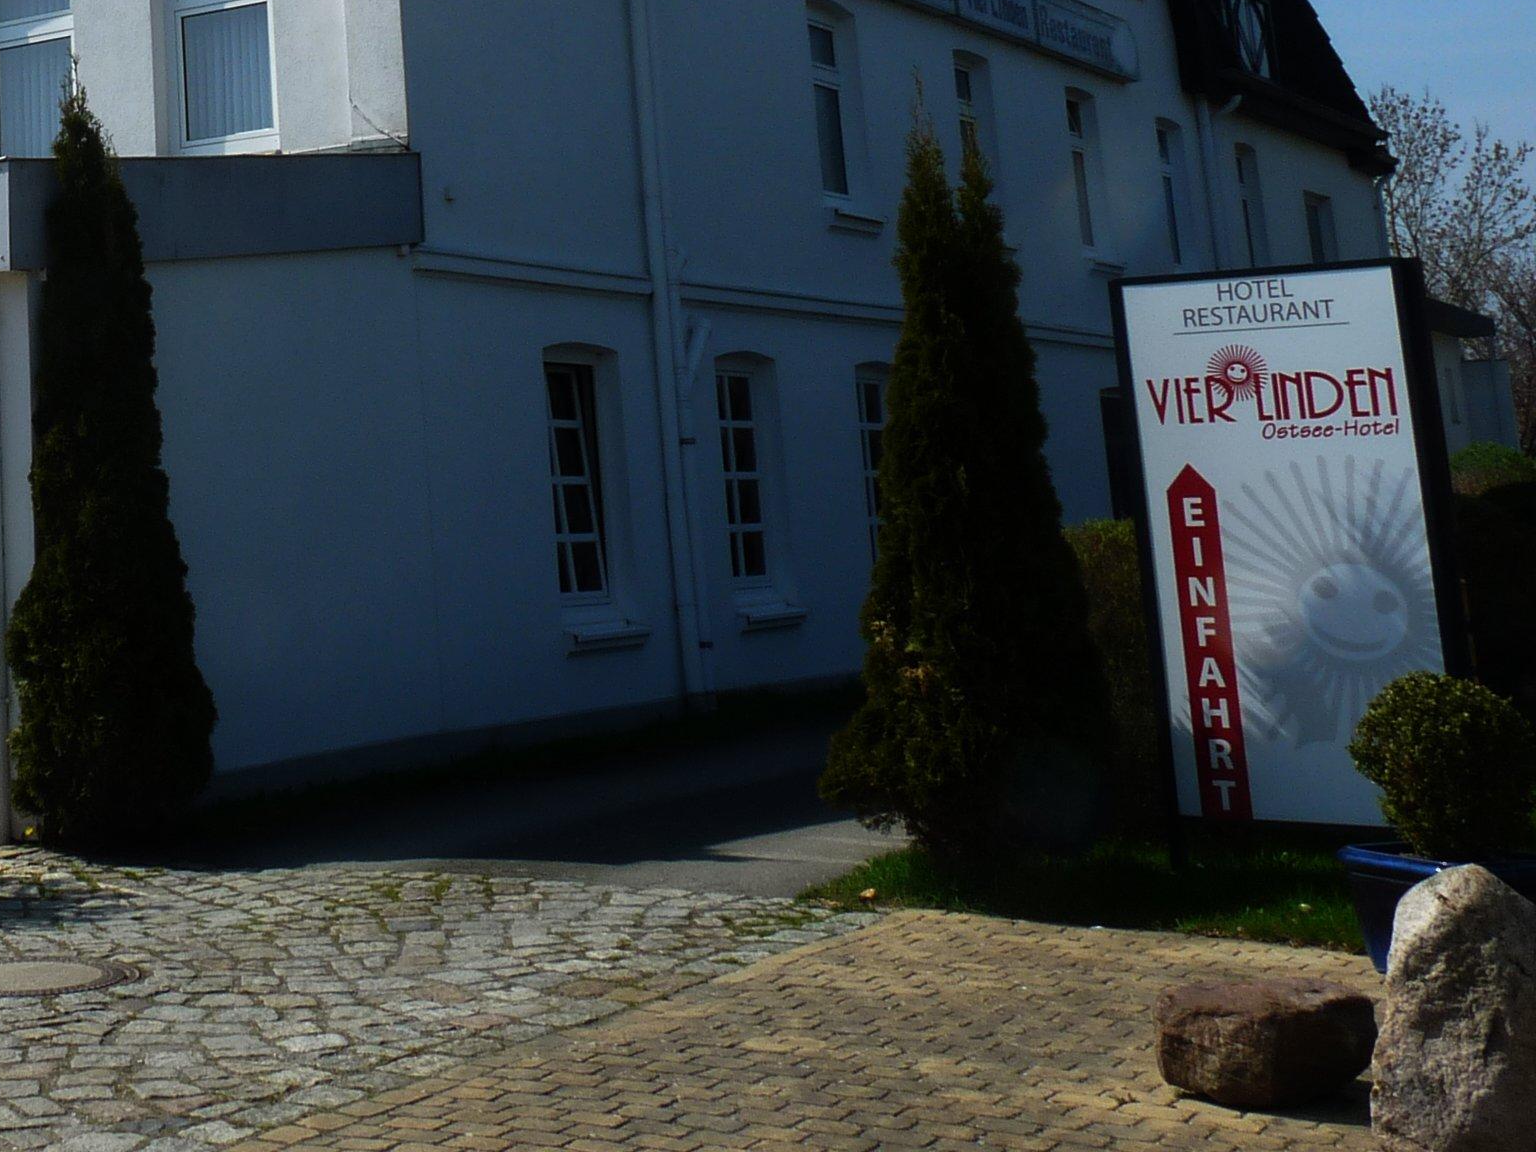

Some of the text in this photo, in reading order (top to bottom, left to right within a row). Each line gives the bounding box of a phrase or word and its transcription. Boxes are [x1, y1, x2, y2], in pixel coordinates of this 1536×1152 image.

[1216, 278, 1294, 302] HOTEL
[1183, 299, 1335, 328] RESTAURANT
[1146, 367, 1399, 426] VIER LINDEN
[1261, 418, 1400, 440] Ostsee-Hotel
[1181, 496, 1236, 812] EINFAHRT
